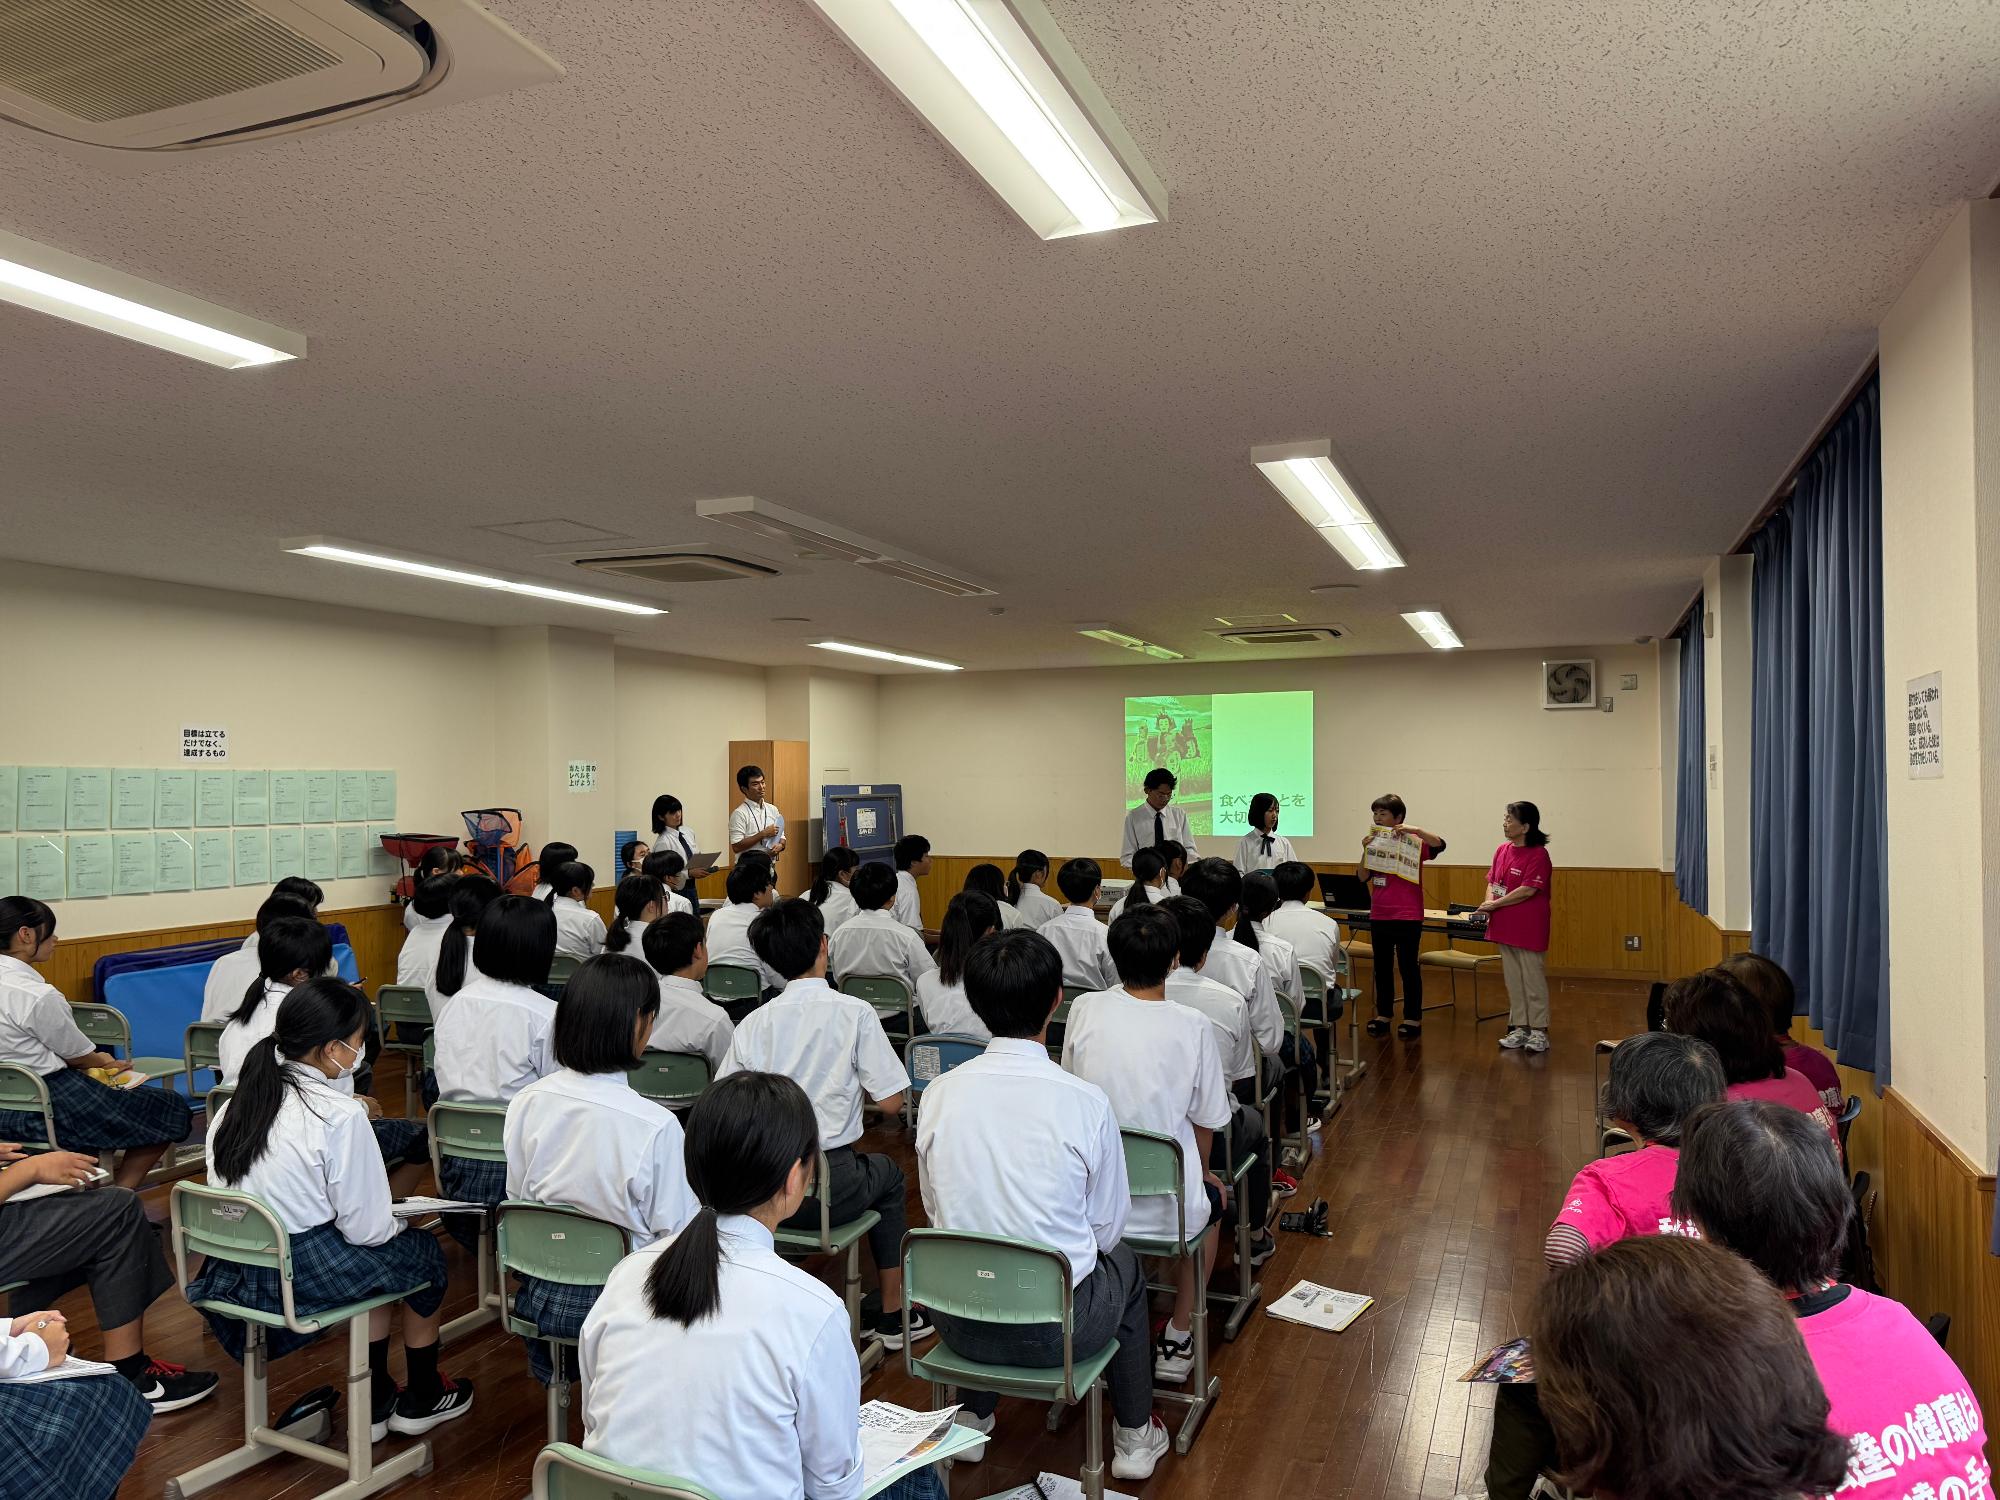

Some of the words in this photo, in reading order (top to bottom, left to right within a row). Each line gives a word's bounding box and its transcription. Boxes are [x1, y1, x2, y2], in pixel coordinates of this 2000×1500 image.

[183, 729, 226, 738] 目標は立てる
[183, 739, 222, 747] だけでなく、
[183, 748, 226, 757] 達成するもの
[1219, 793, 1306, 808] 食べとを
[1828, 1388, 1979, 1500] 達の健康は
